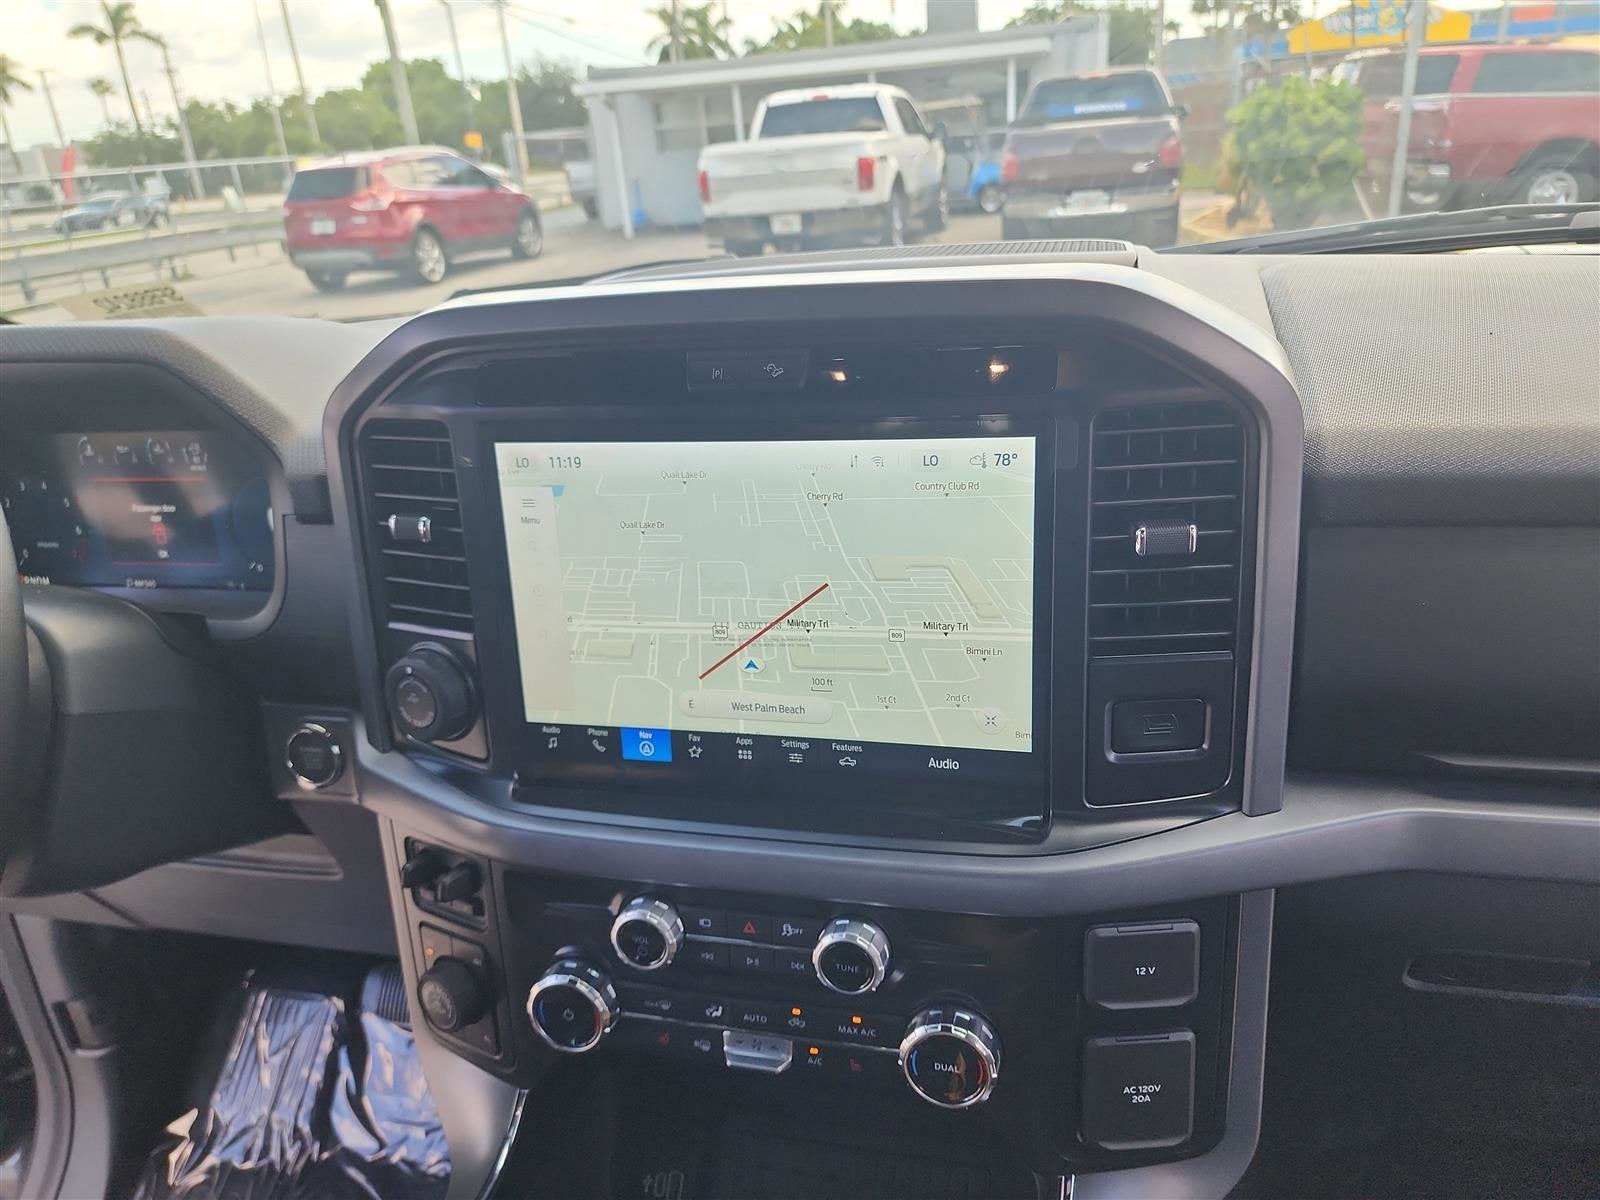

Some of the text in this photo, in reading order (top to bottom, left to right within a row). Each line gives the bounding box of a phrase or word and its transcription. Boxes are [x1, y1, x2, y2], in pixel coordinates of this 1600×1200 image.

[515, 457, 530, 469] LO
[548, 456, 582, 469] 11:19
[922, 455, 939, 467] LO
[660, 470, 680, 479] Quail
[681, 470, 698, 479] Lake
[914, 481, 980, 491] Country Club Rd
[806, 492, 844, 502] Cherry Rd
[520, 516, 541, 525] Menu
[619, 520, 665, 530] Quail Lake Dr
[786, 618, 829, 629] Military Trl
[922, 621, 969, 632] Military Trl
[965, 647, 1003, 657] Bimini Ln
[811, 677, 834, 686] 100 ft
[876, 695, 897, 704] 1st Ct
[945, 694, 970, 703] 2nd Ct
[688, 699, 694, 709] E
[731, 702, 806, 715] West Palm Beach
[541, 725, 561, 735] Audio
[587, 727, 609, 737] Phone
[638, 730, 653, 739] Nav
[688, 733, 701, 743] Fav
[735, 736, 753, 747] Apps
[781, 739, 810, 750] Settings
[831, 742, 863, 753] Features
[928, 757, 960, 771] Audio
[835, 963, 860, 973] TUNE
[1135, 966, 1156, 976] 12 V
[743, 1013, 768, 1024] AUTO
[838, 1025, 877, 1037] MAX A/C
[807, 1057, 823, 1066] A/C
[934, 1062, 960, 1073] DUAL
[1123, 1084, 1162, 1094] AC 120V
[1132, 1095, 1151, 1103] 20A
